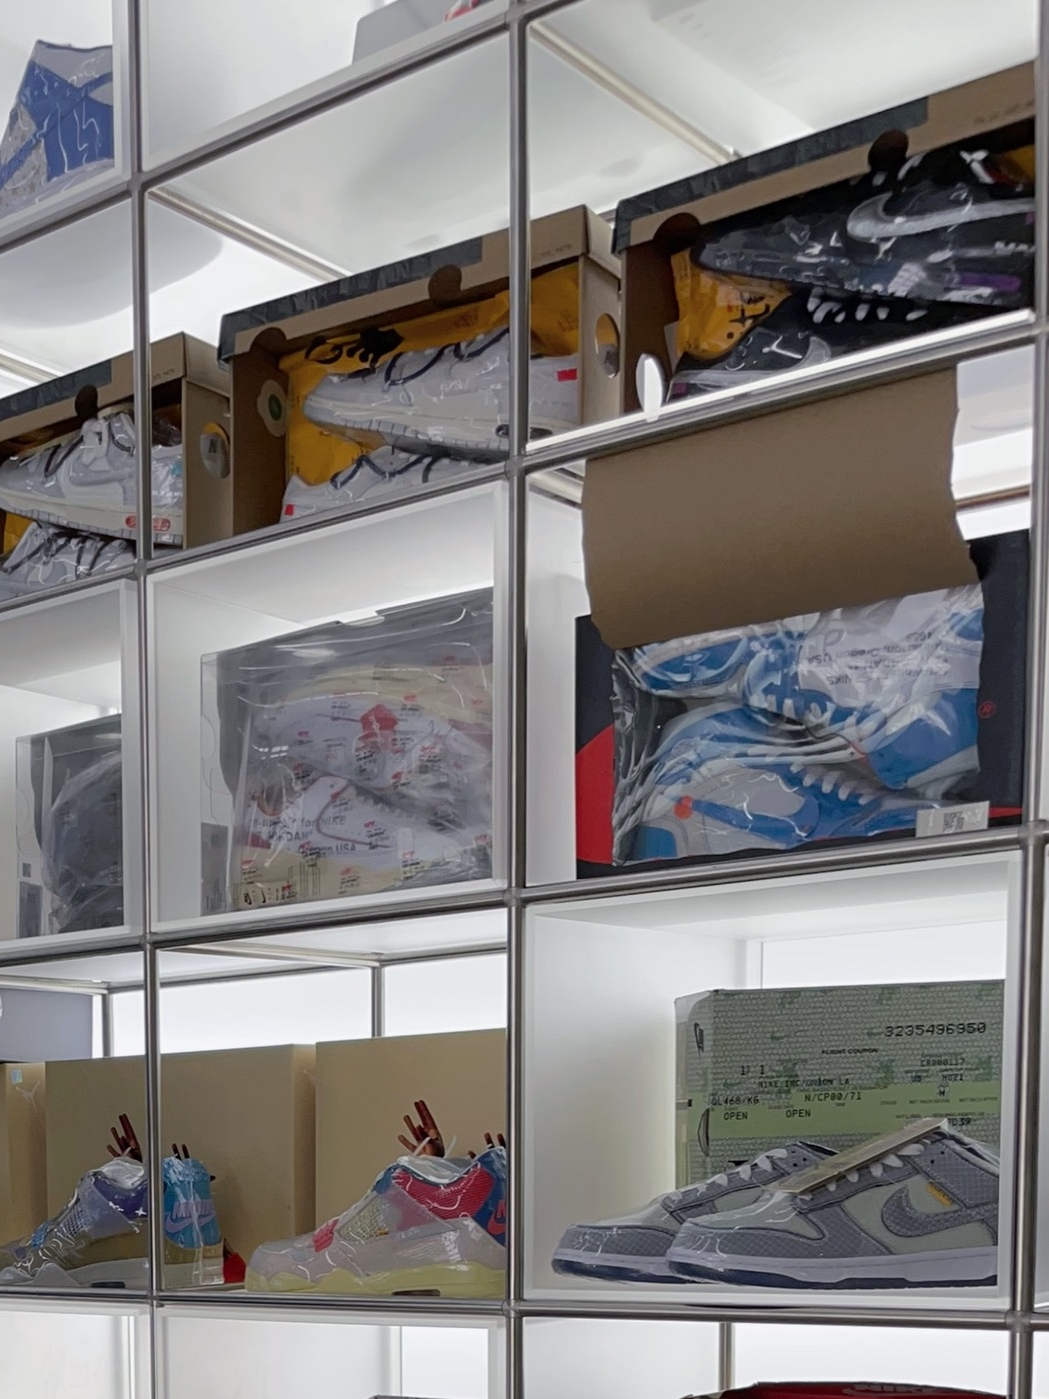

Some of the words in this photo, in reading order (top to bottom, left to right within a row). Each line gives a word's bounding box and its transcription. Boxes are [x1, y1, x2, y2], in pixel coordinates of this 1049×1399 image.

[884, 1021, 987, 1038] 3235496950
[723, 1111, 749, 1121] OPEN
[785, 1108, 812, 1119] OPEN
